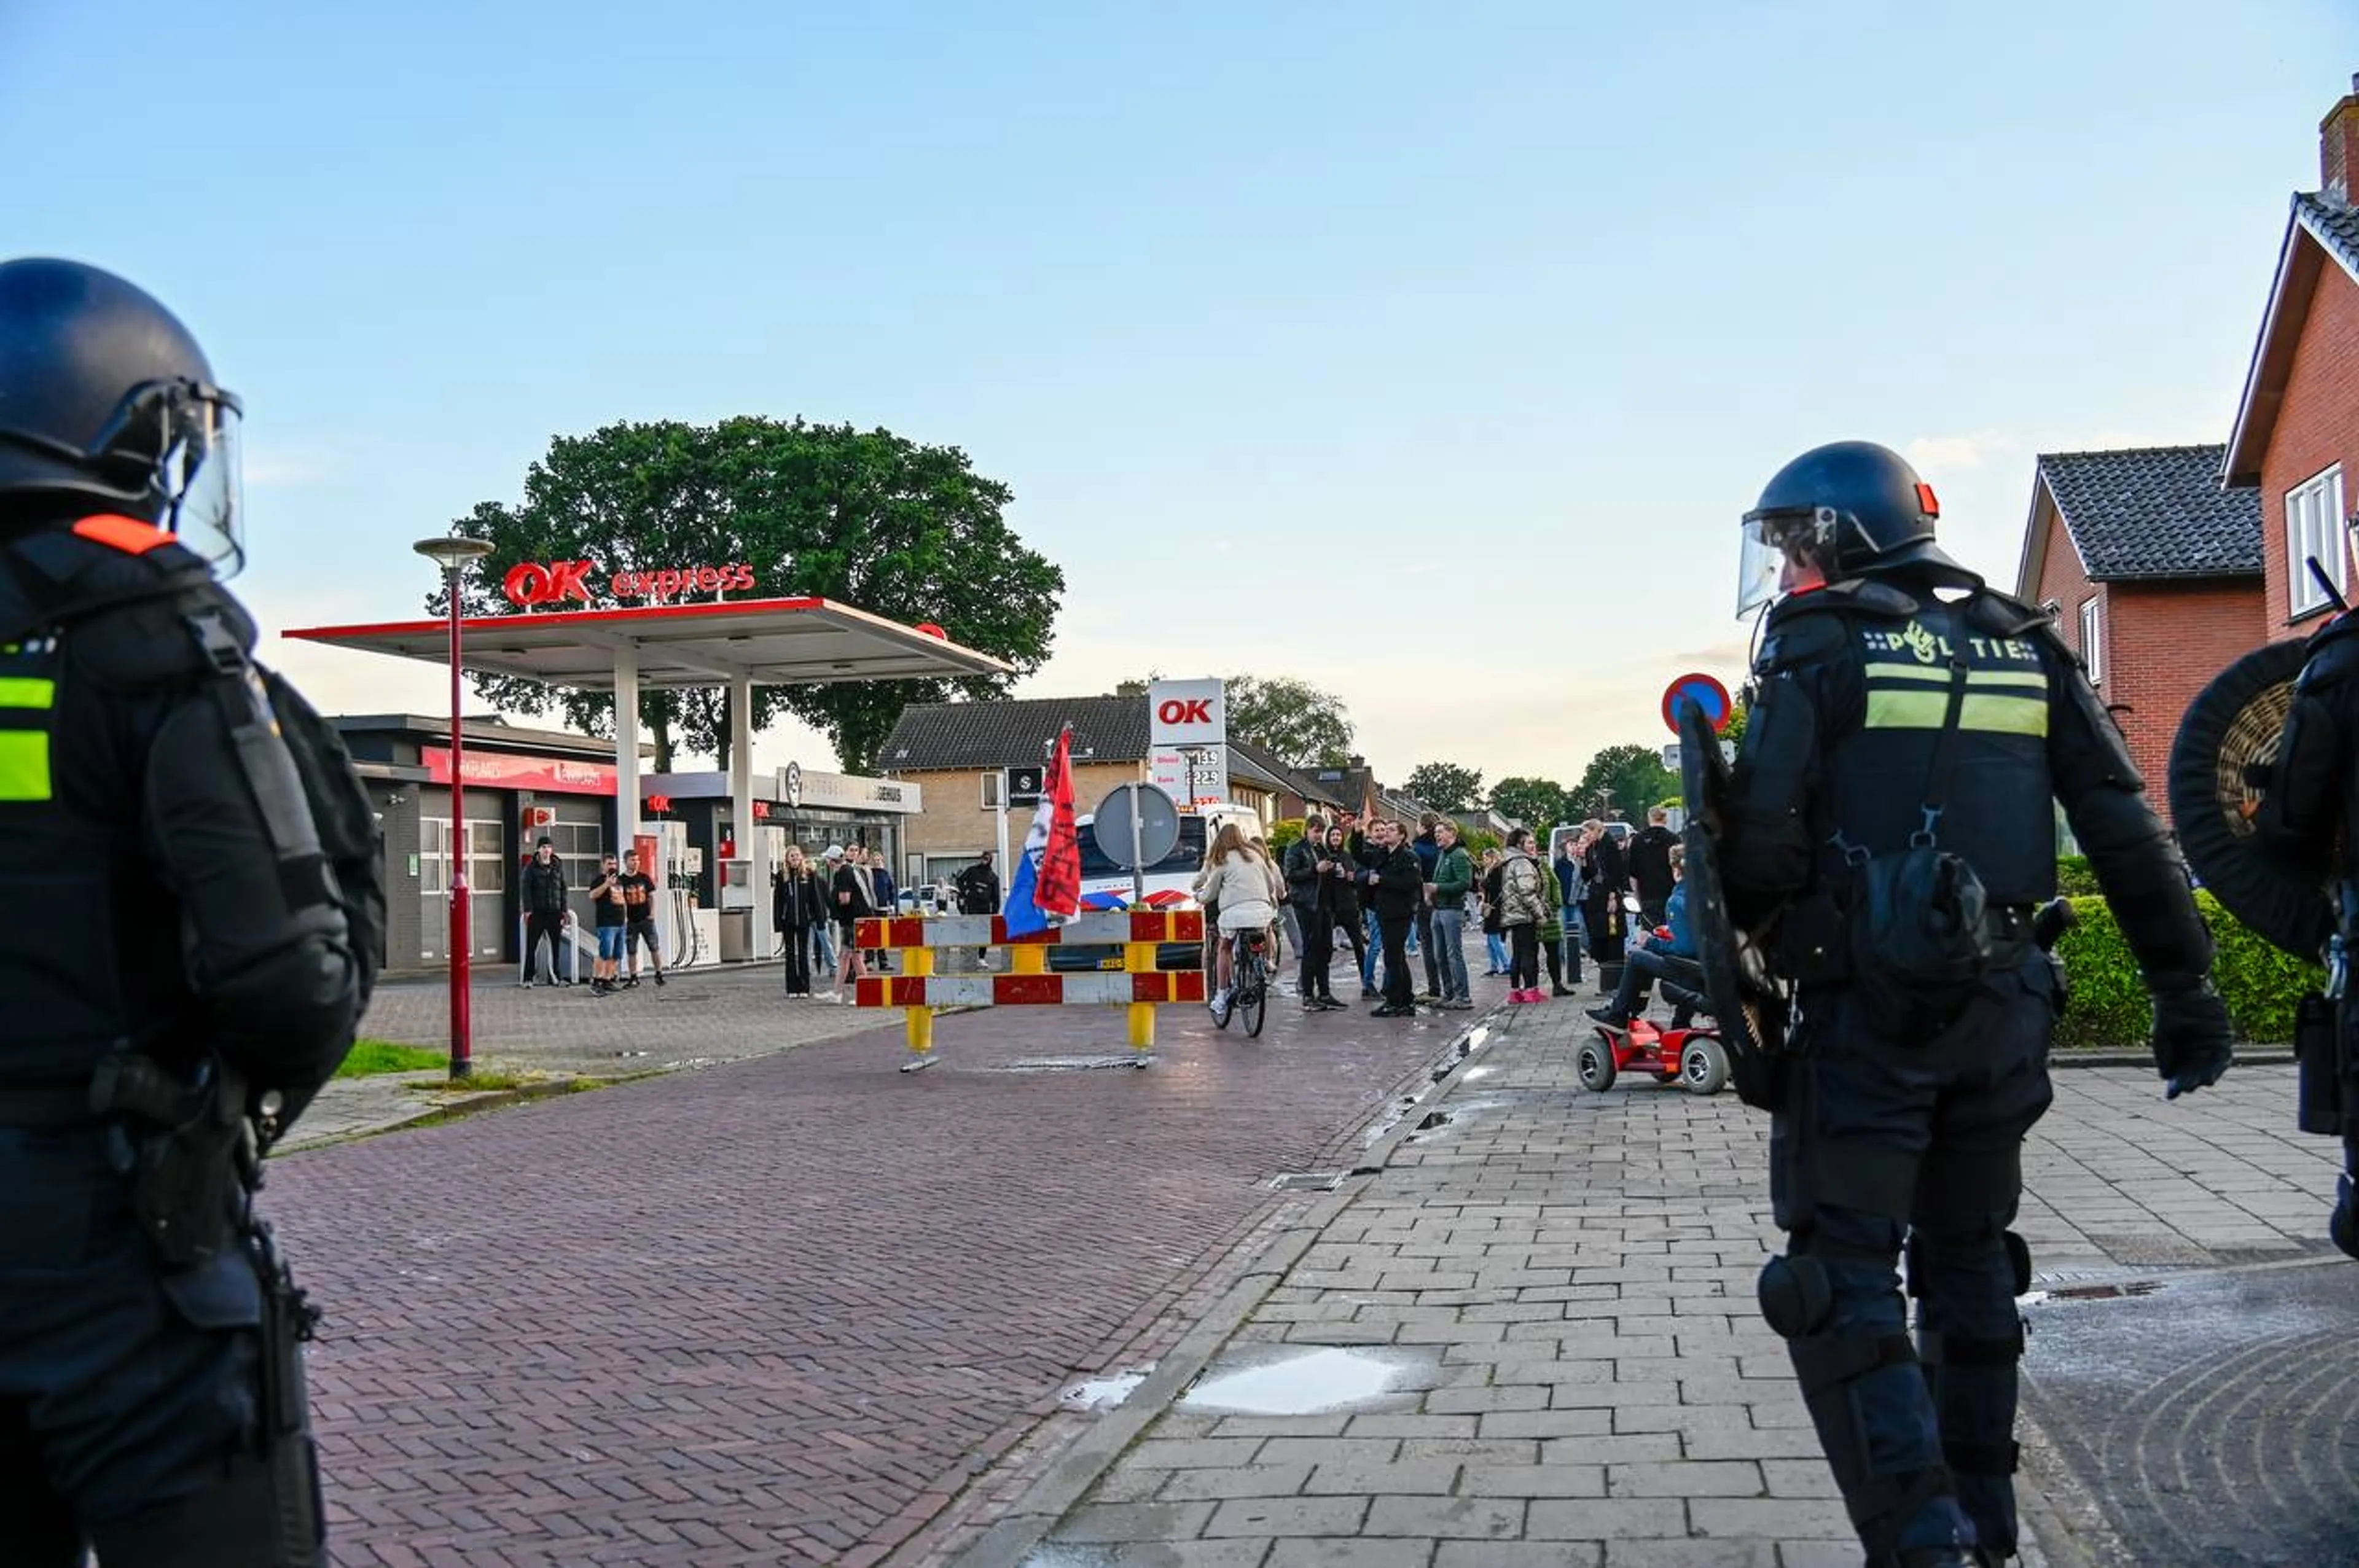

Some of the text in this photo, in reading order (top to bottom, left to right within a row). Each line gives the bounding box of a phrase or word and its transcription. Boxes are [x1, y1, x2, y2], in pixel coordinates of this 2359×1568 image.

[504, 559, 755, 605] OK express
[1885, 626, 2022, 663] POLTIE
[1159, 698, 1213, 724] OK
